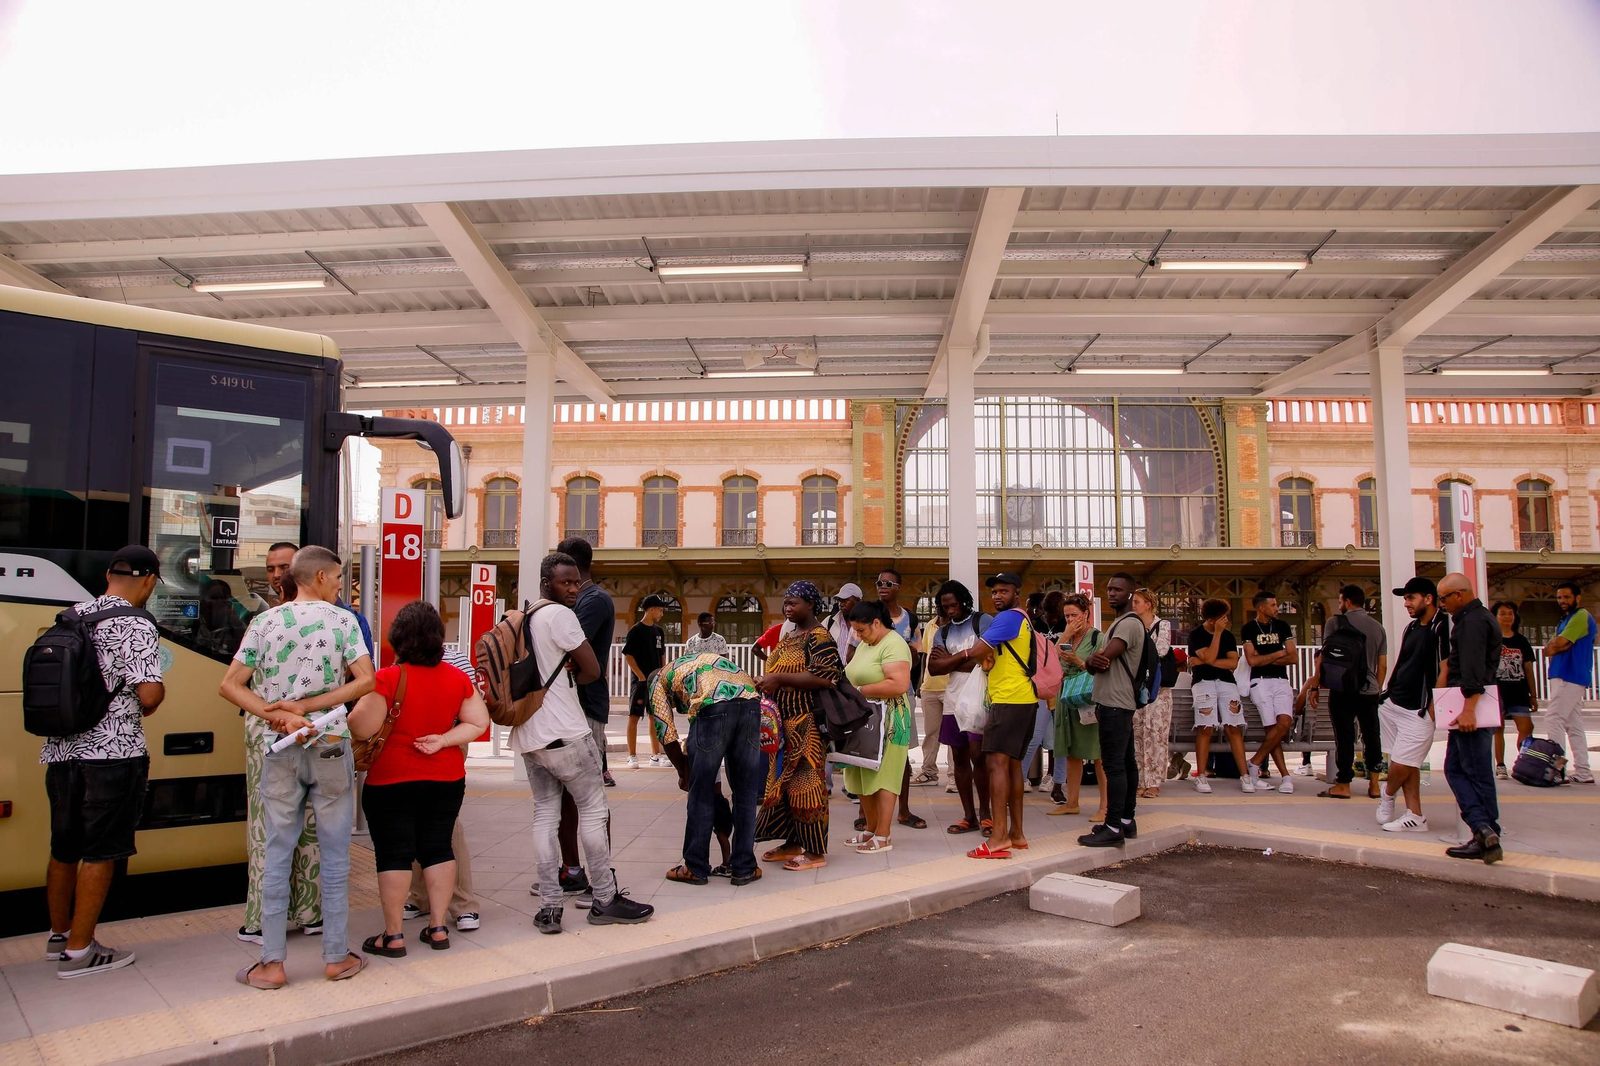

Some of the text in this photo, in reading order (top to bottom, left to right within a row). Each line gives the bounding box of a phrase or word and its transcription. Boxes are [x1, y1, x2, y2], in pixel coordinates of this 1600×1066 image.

[211, 374, 256, 391] S 419 UL
[395, 493, 412, 519] D
[1462, 490, 1470, 517] D
[215, 538, 240, 546] ENTRADA
[384, 533, 421, 560] 18
[1461, 531, 1475, 559] 19
[479, 567, 490, 583] D
[1082, 564, 1089, 581] D
[473, 589, 494, 605] 03
[1256, 633, 1280, 645] ICON
